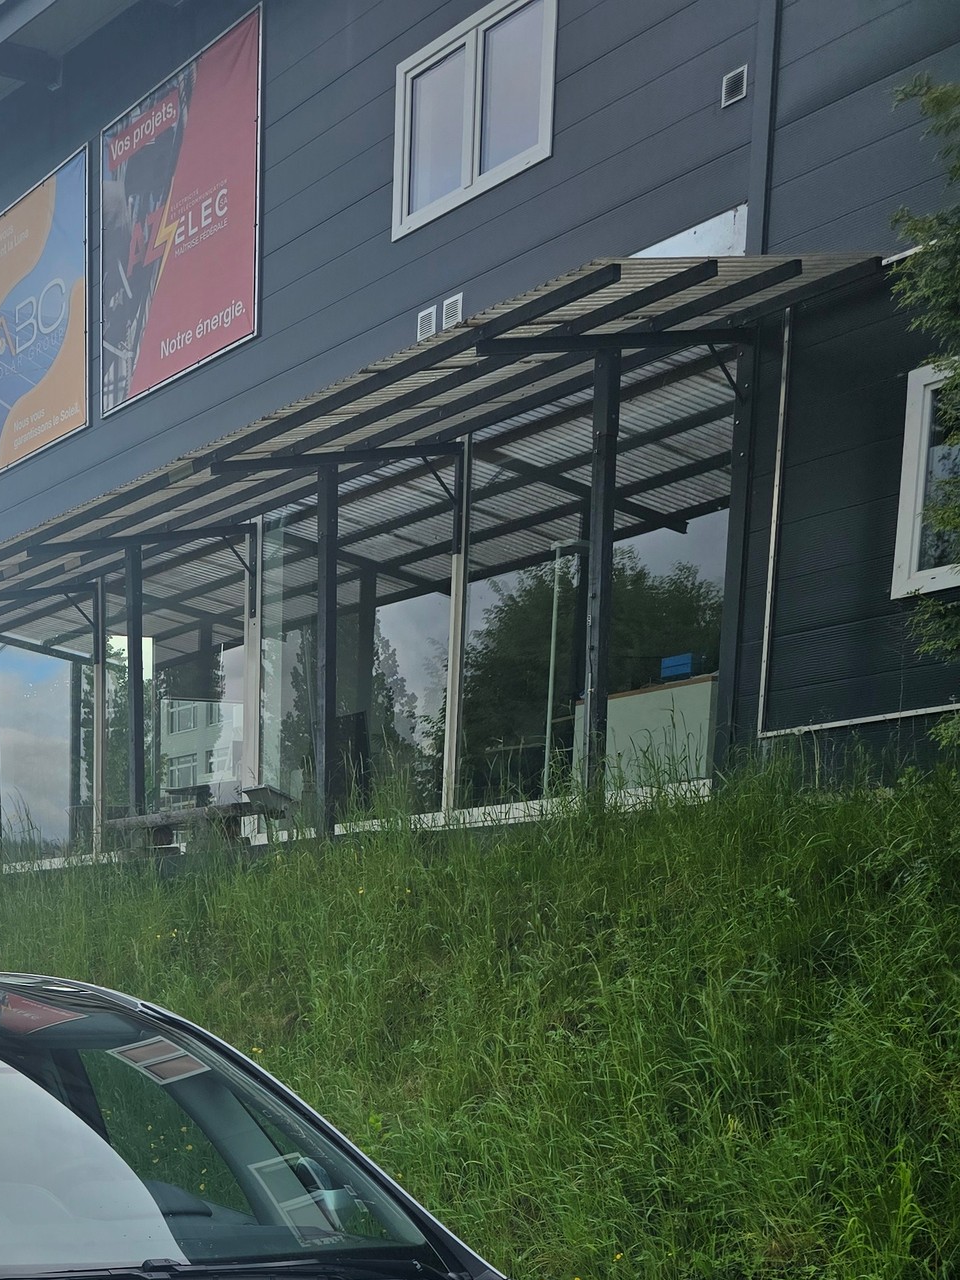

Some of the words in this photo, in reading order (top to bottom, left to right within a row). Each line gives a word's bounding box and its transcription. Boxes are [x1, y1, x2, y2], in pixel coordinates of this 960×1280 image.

[111, 135, 130, 161] Vos
[133, 102, 177, 149] projets,
[27, 327, 64, 361] GROUP
[160, 329, 193, 360] Notre
[195, 299, 246, 339] énergie.
